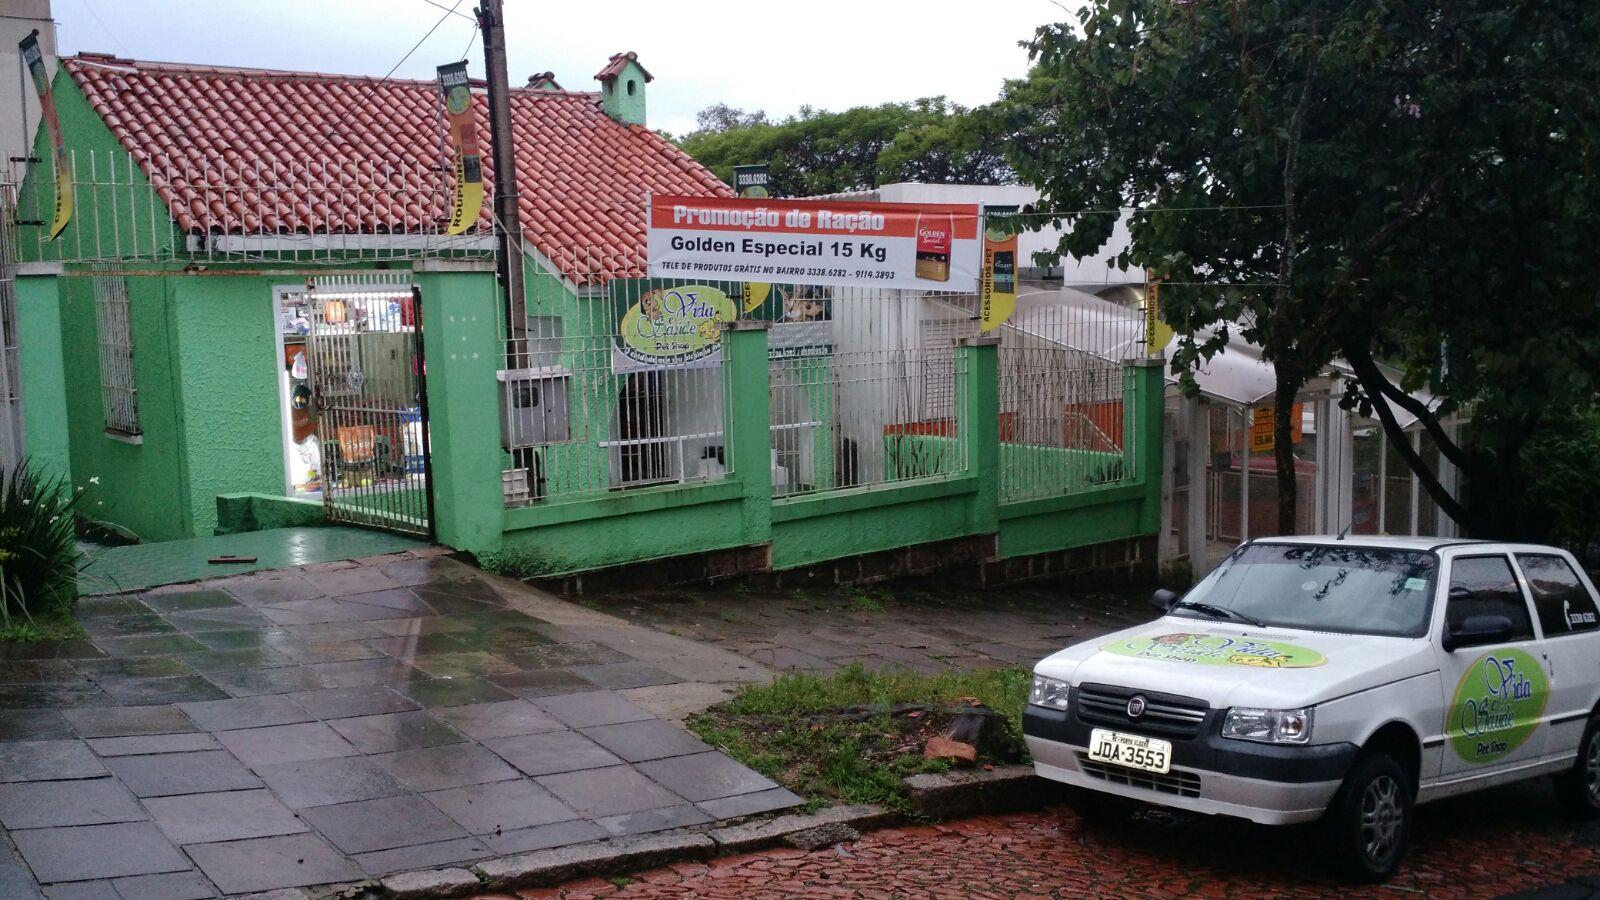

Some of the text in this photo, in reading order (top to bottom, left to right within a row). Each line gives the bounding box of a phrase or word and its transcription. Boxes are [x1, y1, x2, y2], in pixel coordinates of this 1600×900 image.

[453, 145, 463, 227] ROUPINHAS
[673, 205, 885, 232] Promoção de Ração
[671, 236, 887, 262] Golden Especial 15 Kg
[662, 261, 679, 270] TELE
[681, 262, 691, 270] DE
[693, 263, 732, 272] PRODUTOS
[763, 266, 774, 274] NO
[776, 266, 805, 275] BAIRRO
[807, 267, 847, 277] 3338.6282
[855, 270, 895, 279] 9114.3893
[664, 290, 715, 318] Vida
[1485, 657, 1531, 699] Vida
[1477, 743, 1489, 756] Pet
